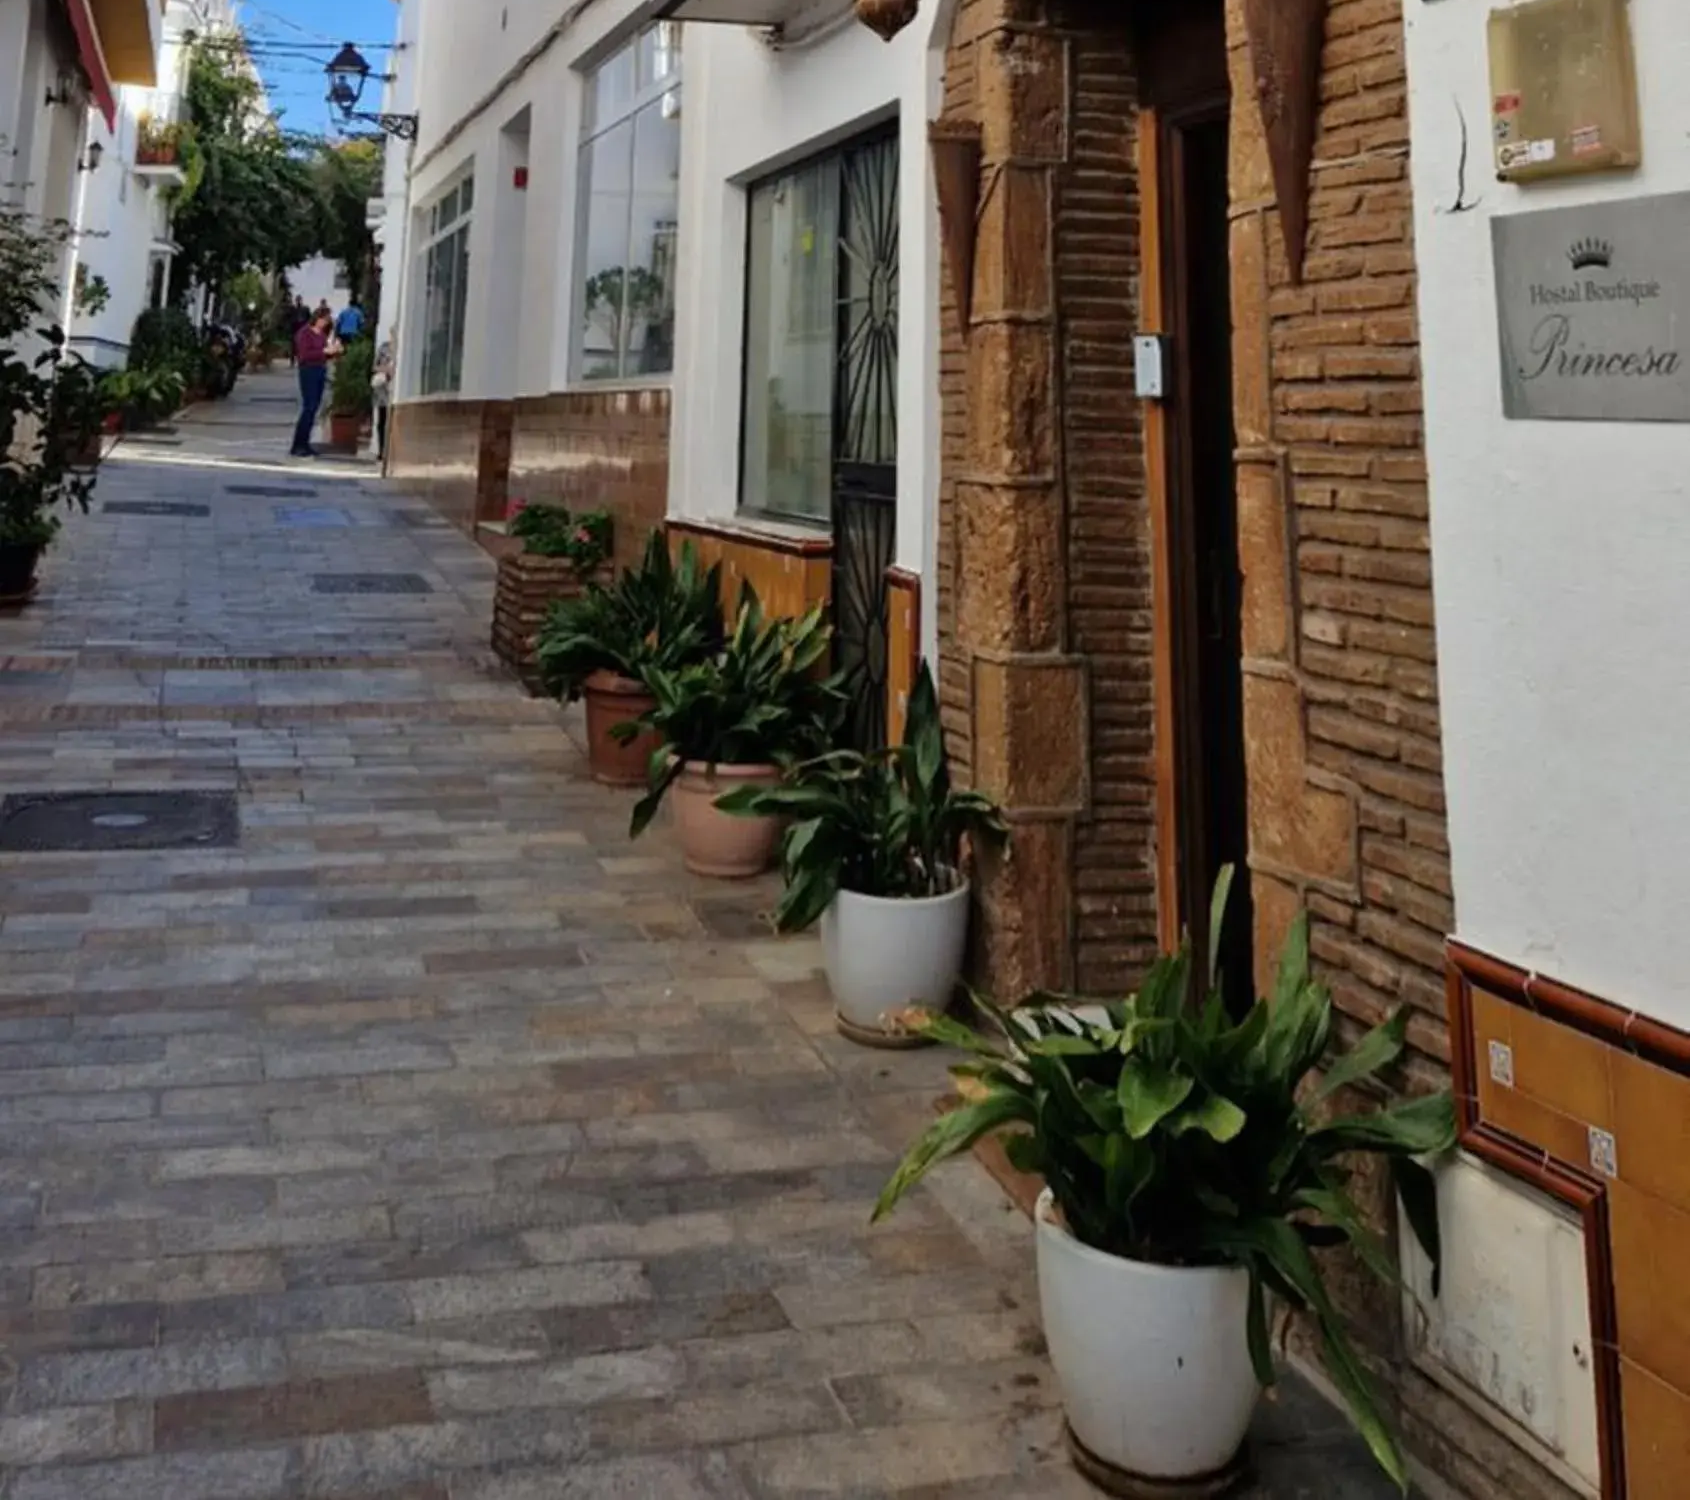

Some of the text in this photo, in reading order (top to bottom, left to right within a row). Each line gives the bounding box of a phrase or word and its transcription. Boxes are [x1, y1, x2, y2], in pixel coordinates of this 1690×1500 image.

[1529, 278, 1661, 307] Hostal Boutique
[1518, 313, 1682, 380] Princesa
